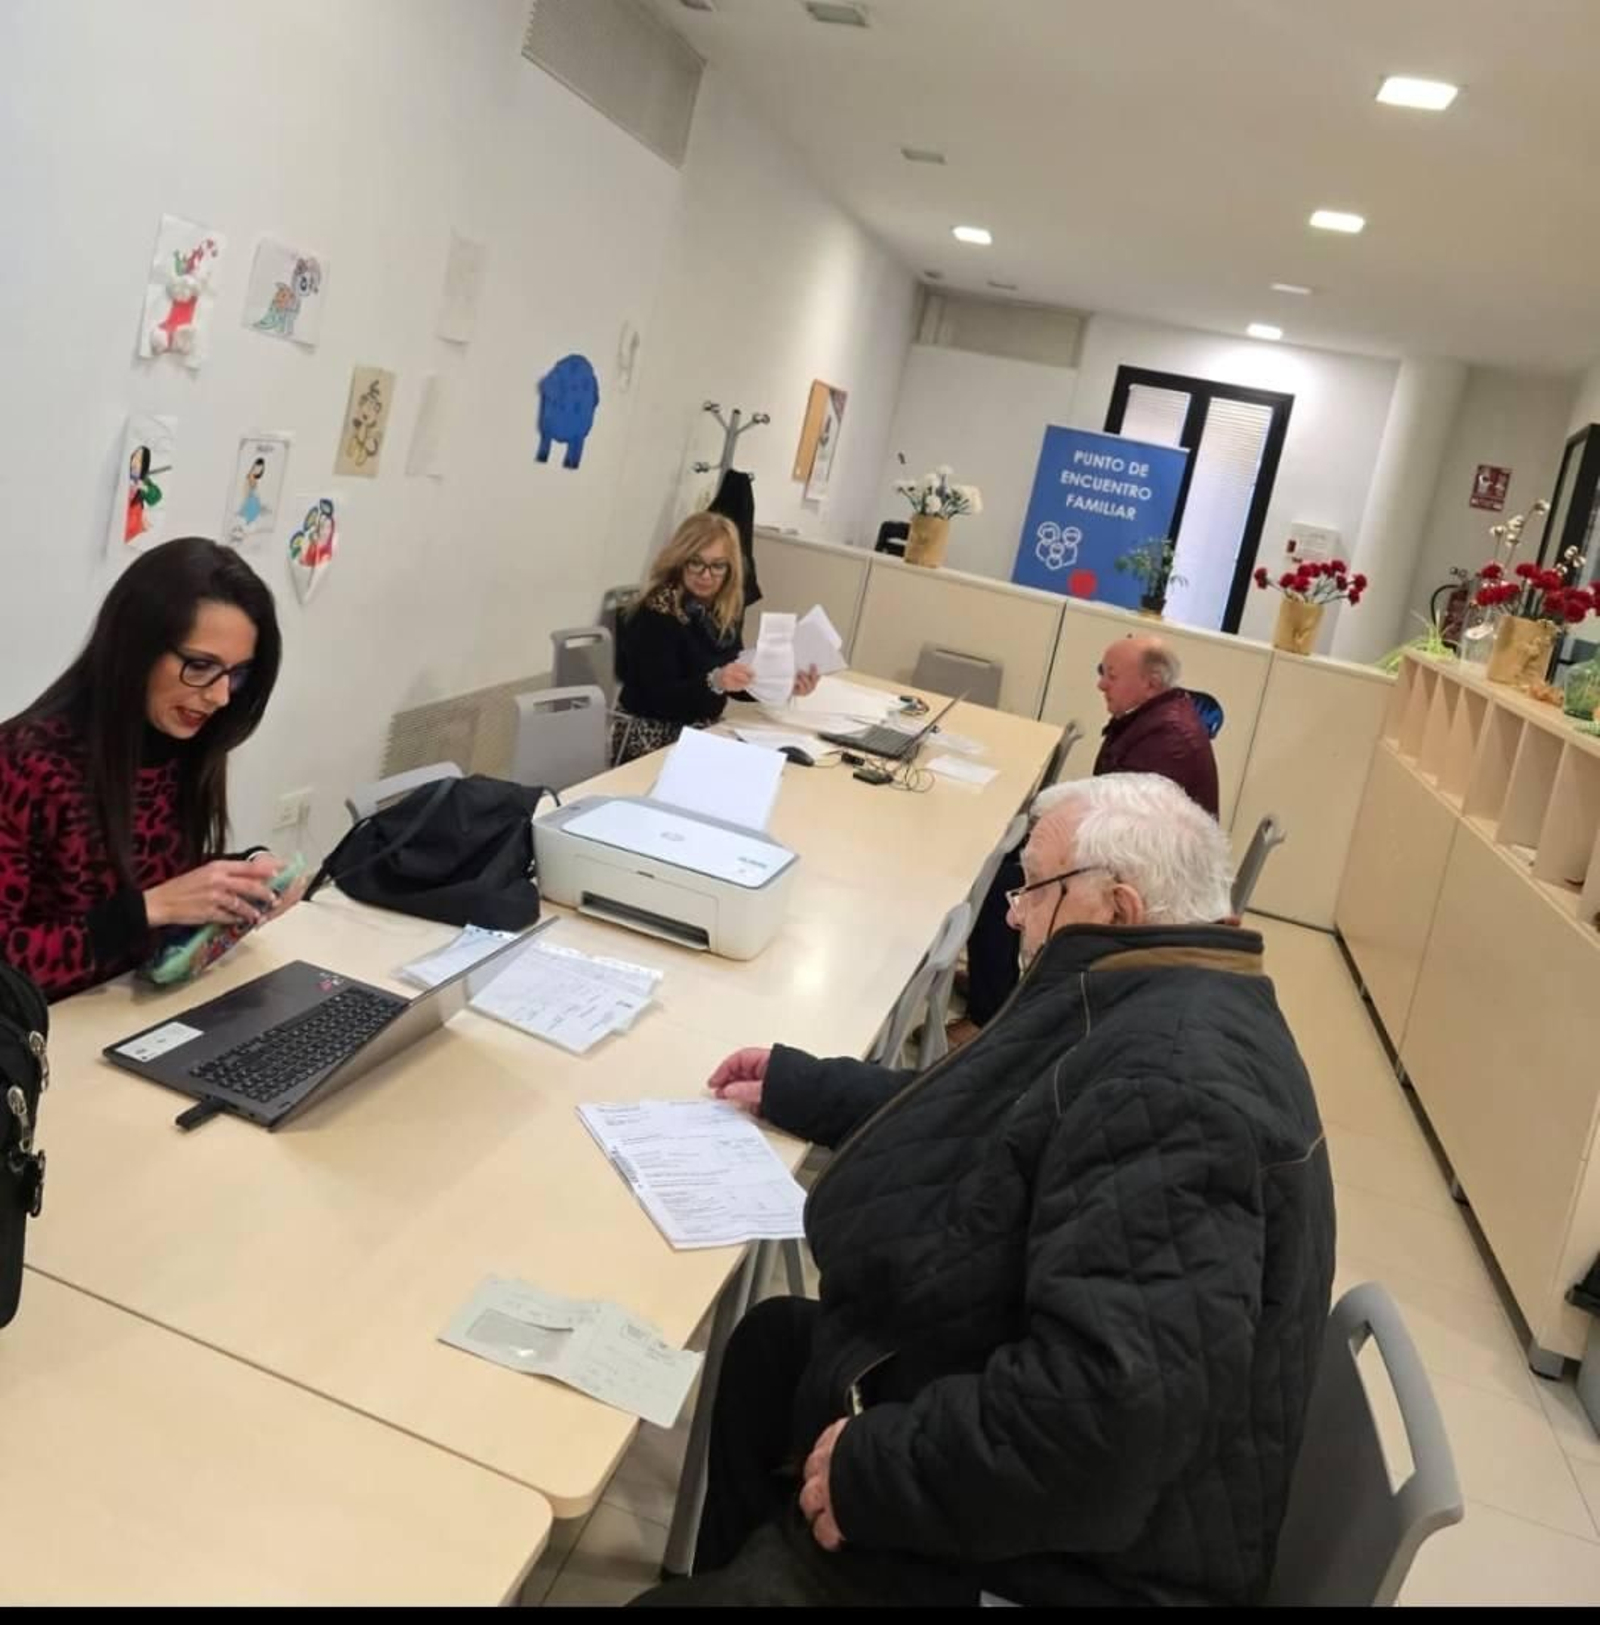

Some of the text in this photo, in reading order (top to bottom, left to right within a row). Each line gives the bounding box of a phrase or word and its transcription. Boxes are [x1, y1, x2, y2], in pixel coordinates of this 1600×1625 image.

[1074, 450, 1149, 477] PUNTO DE
[1060, 470, 1152, 500] ENCUENTRO
[1066, 494, 1137, 520] FAMILIAR
